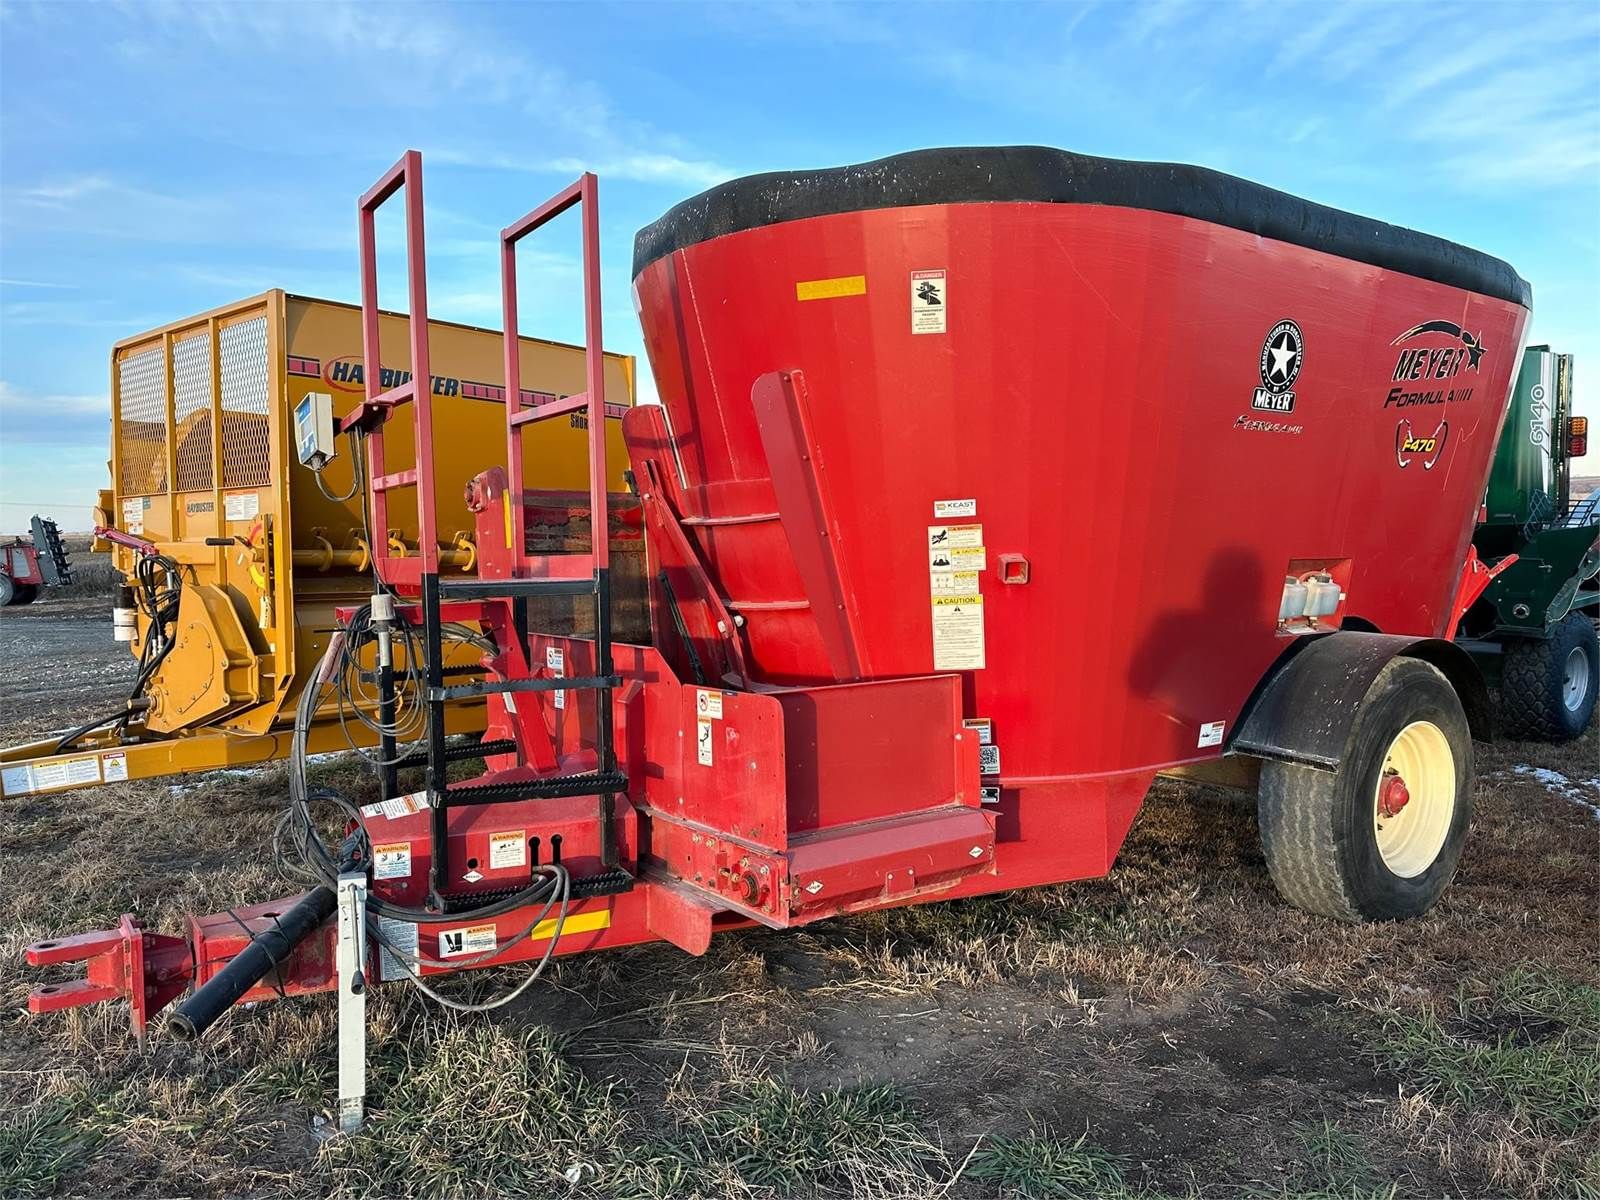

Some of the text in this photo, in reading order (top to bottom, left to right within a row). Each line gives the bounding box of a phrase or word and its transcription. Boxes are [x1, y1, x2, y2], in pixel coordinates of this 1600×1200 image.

[1391, 348, 1465, 382] MEYER
[332, 361, 459, 397] HABUER
[1254, 389, 1291, 410] MEYER
[570, 413, 588, 430] SHOR
[1530, 384, 1545, 446] 6140
[1402, 438, 1436, 452] F470
[187, 502, 214, 513] HAYBUSTER
[943, 597, 976, 605] CAUTION
[497, 832, 523, 840] WARNING
[381, 844, 409, 852] WARNING
